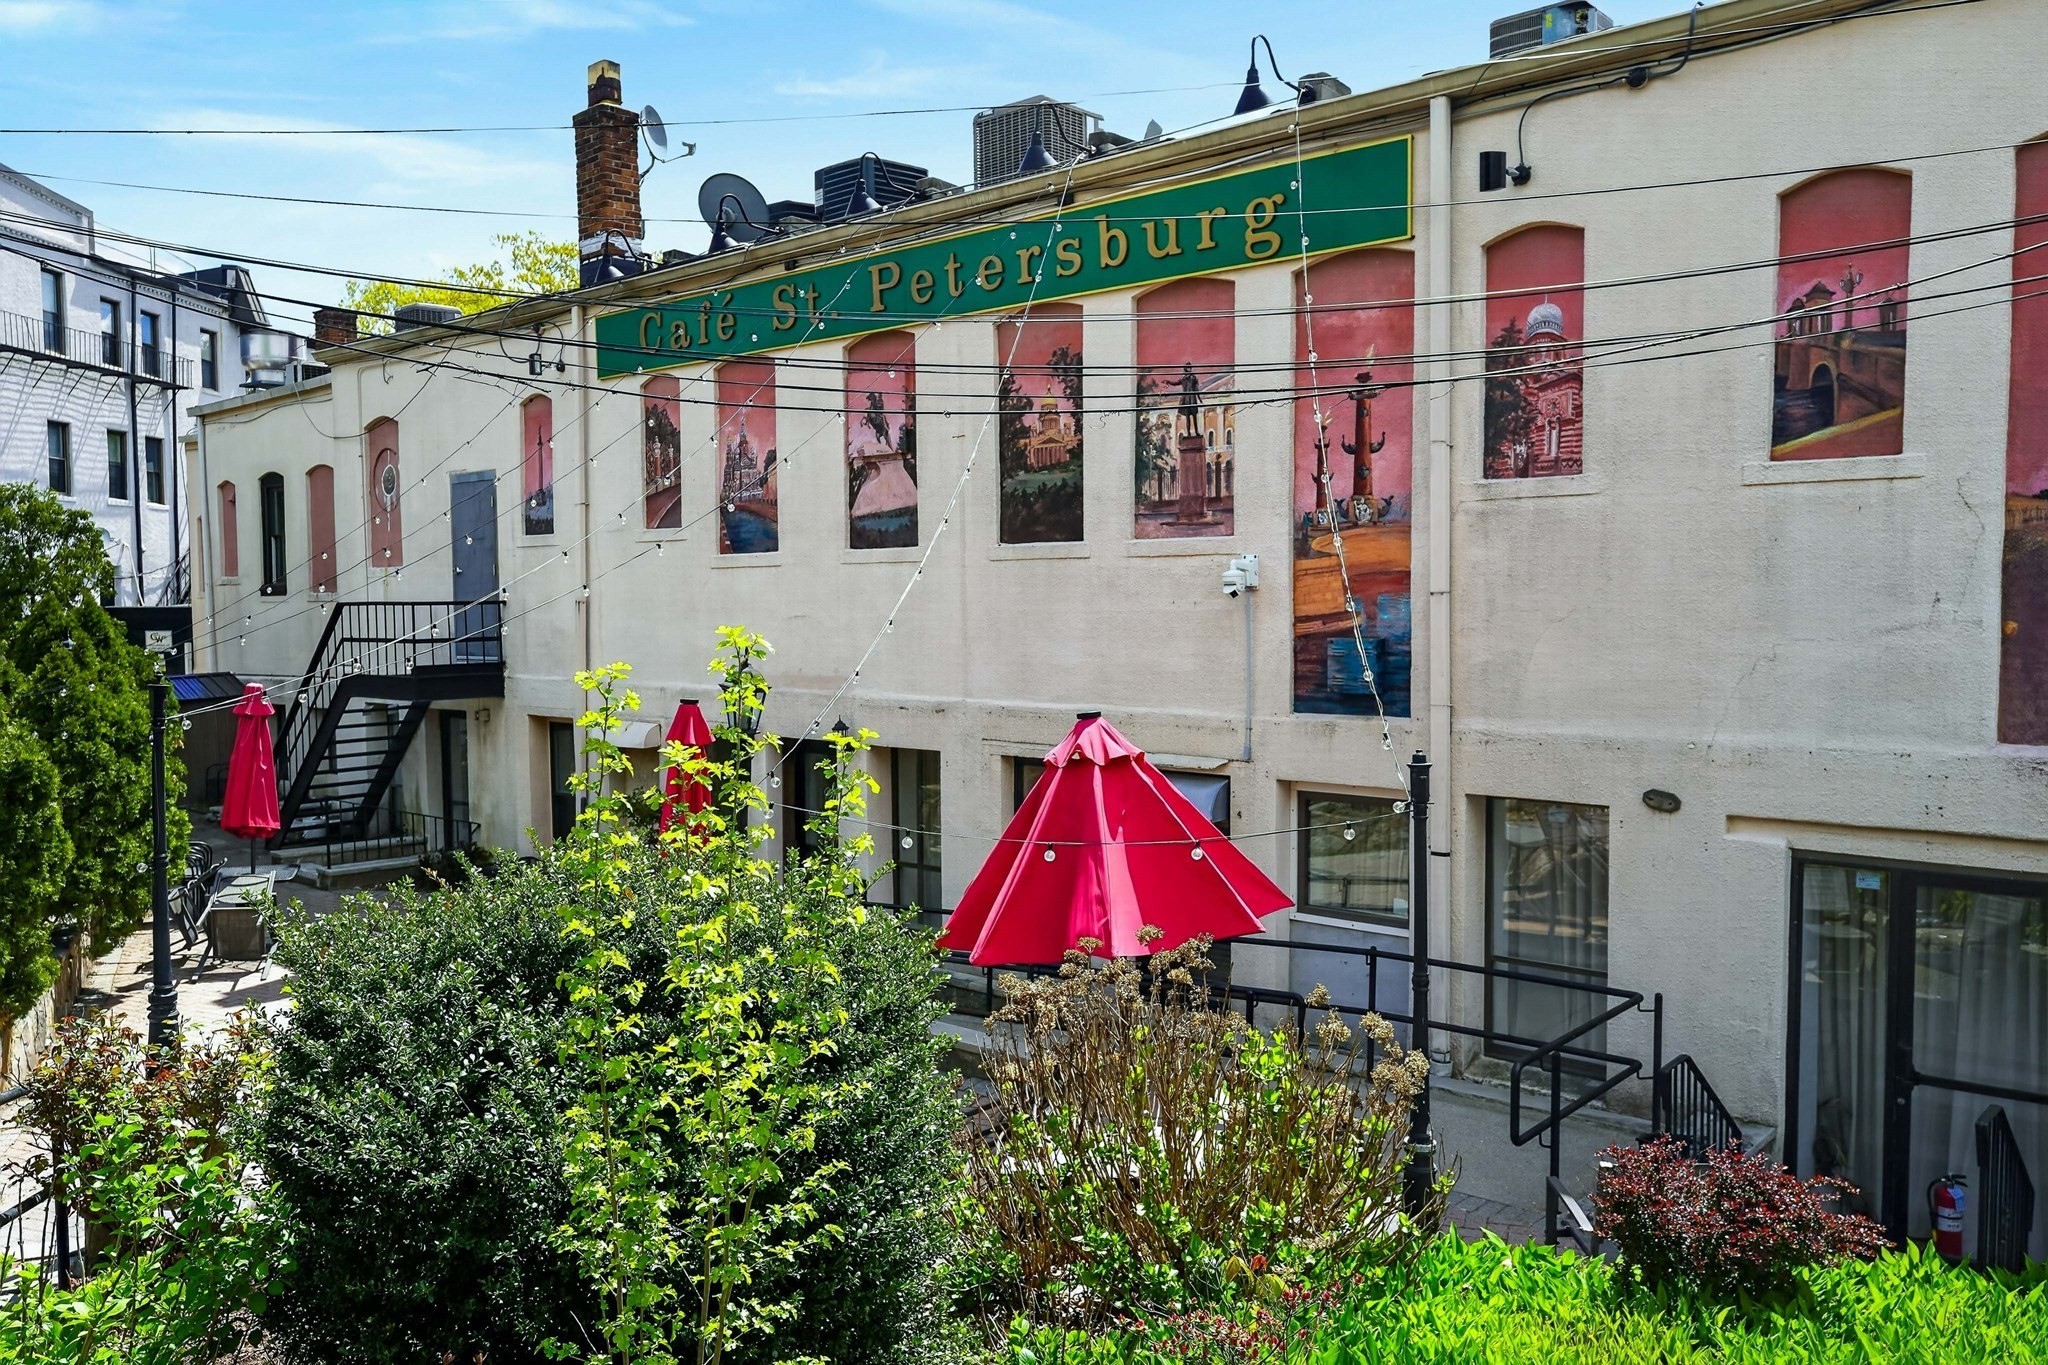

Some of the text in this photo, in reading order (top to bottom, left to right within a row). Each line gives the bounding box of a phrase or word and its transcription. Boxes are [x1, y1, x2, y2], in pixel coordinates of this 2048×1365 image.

[639, 193, 1286, 353] Café St. Petersburg
